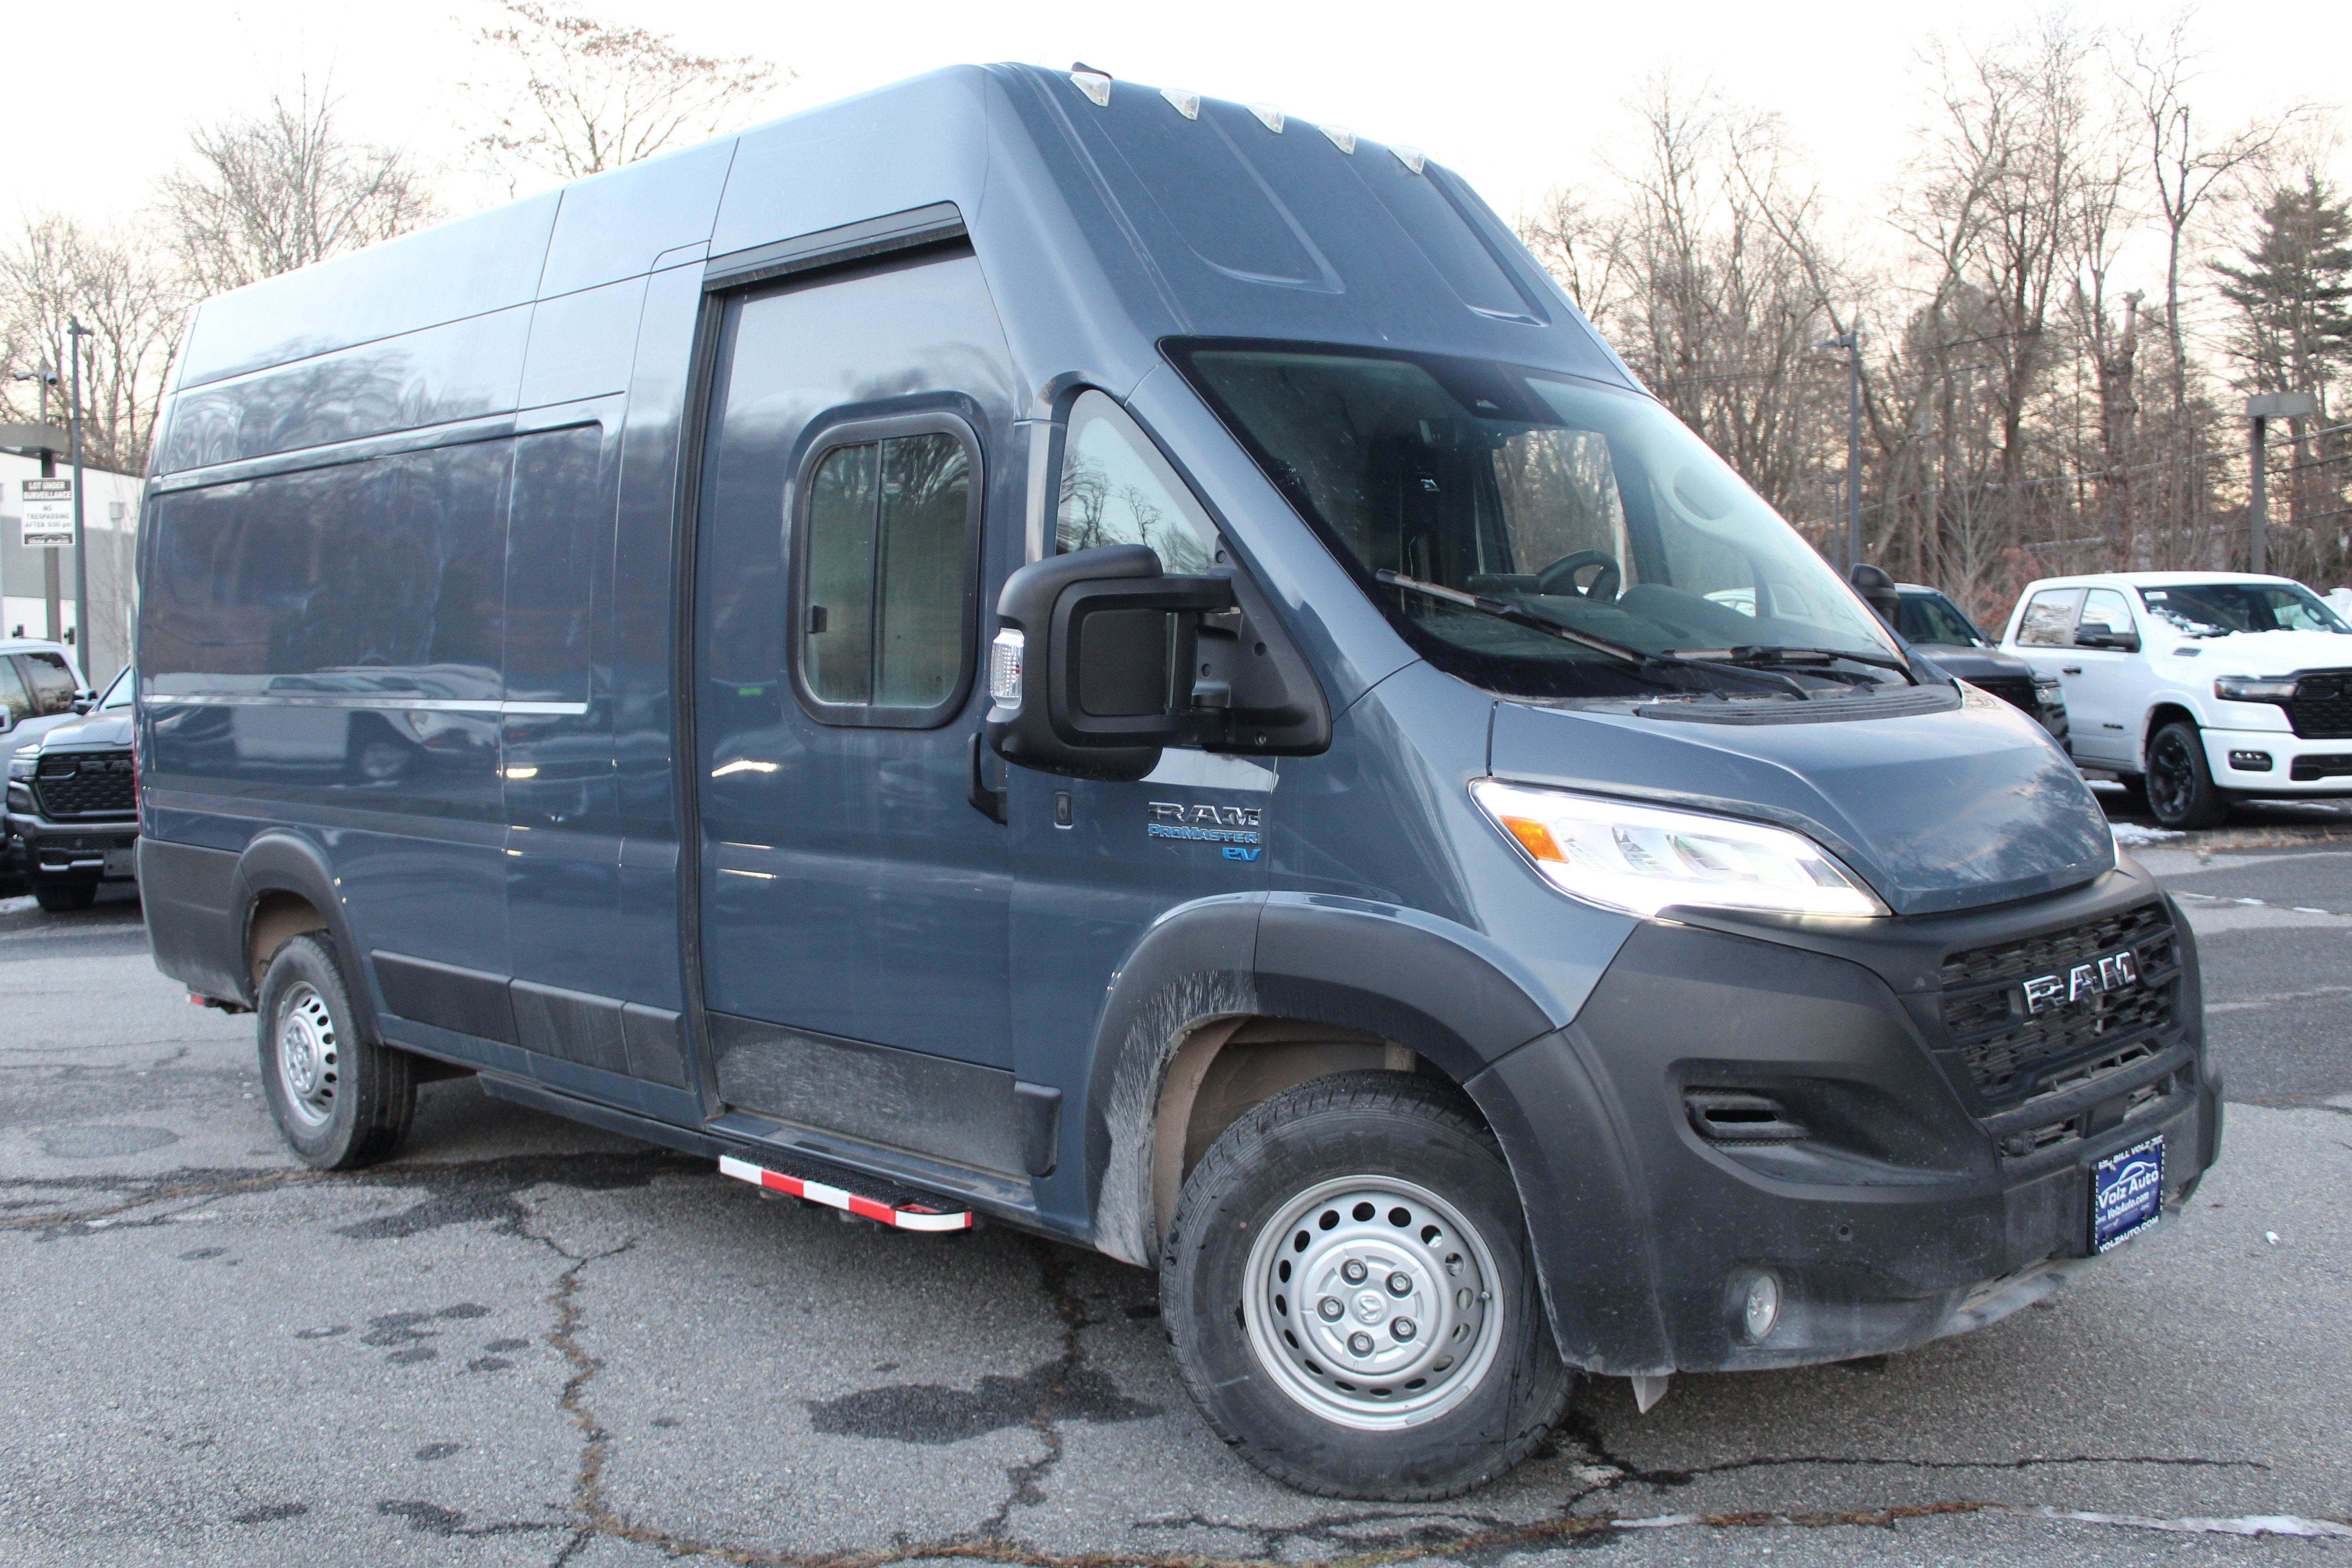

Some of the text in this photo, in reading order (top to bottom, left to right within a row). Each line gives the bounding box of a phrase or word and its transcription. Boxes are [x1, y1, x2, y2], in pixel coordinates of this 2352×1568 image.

[24, 491, 72, 499] SURVEILLANCE
[29, 481, 65, 490] LOT UNDER
[80, 760, 133, 773] RA
[1148, 802, 1261, 827] RAM
[2023, 951, 2136, 1014] RAM
[2113, 1150, 2130, 1163] BILL
[2131, 1140, 2151, 1155] VOLZ
[2098, 1170, 2159, 1209] Volz Auto
[2107, 1191, 2150, 1220] VolzAuto.com
[2099, 1215, 2159, 1253] VOLZAUTO.COM
